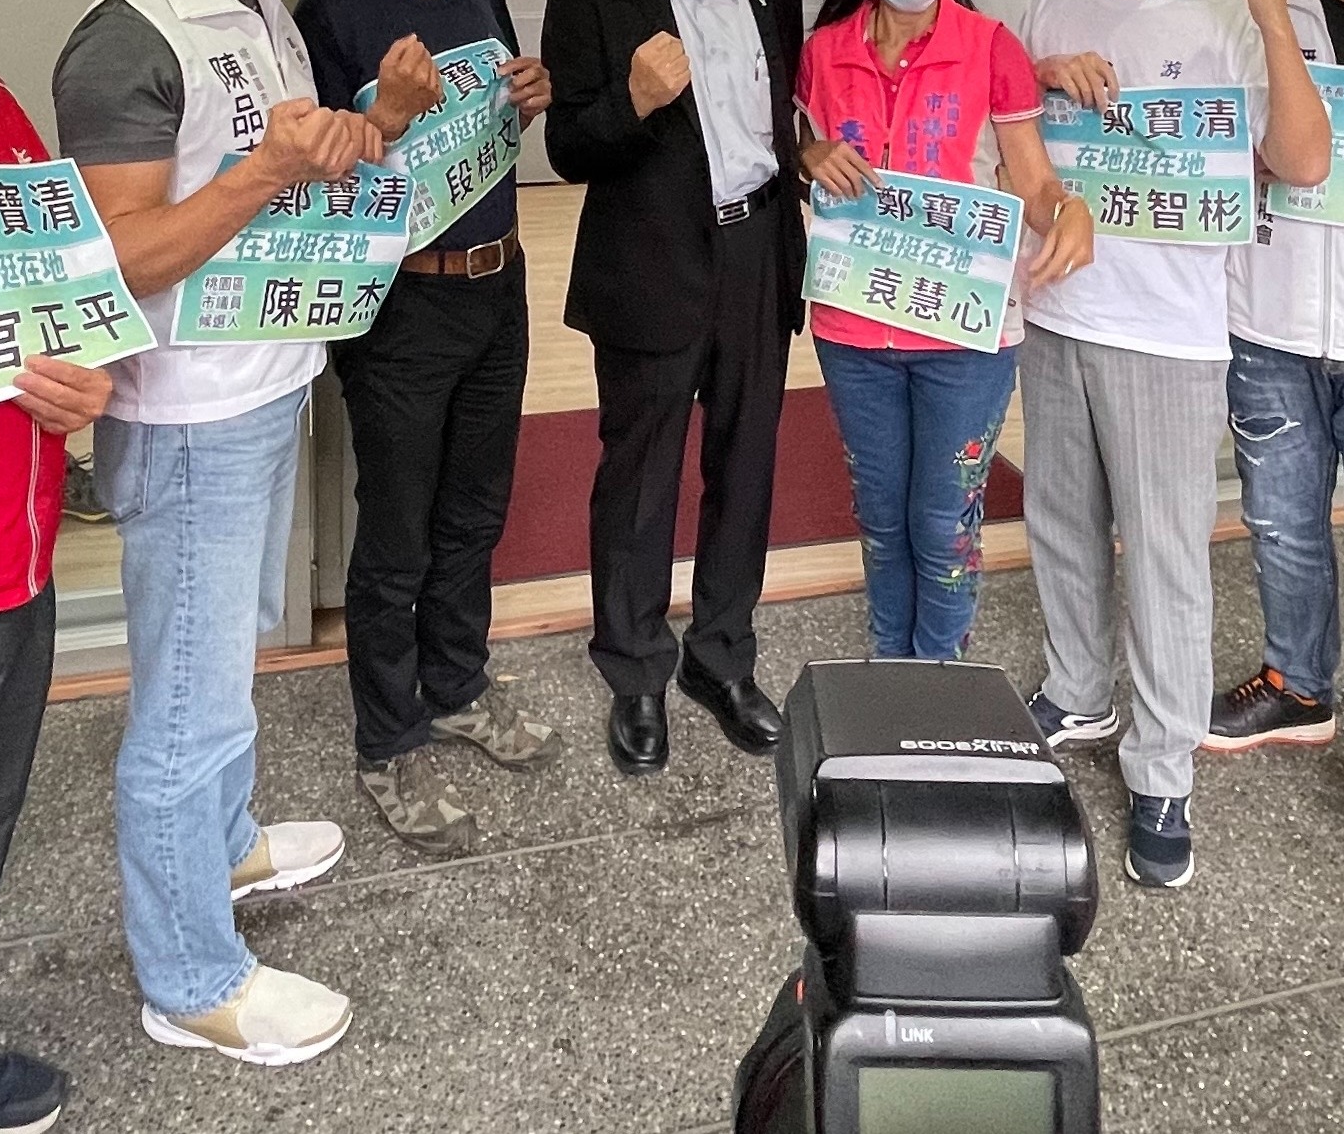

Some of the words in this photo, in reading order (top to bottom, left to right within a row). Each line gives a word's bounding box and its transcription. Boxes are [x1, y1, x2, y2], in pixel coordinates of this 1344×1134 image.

[1102, 98, 1238, 140] 鄭寶清
[445, 117, 517, 207] 段樹文
[1075, 145, 1207, 178] 在地挺在地
[269, 176, 406, 221] 鄭寶清
[876, 185, 1011, 245] 鄭寶清
[1099, 184, 1244, 233] 游智彬
[236, 230, 370, 263] 在地挺在地
[848, 223, 974, 276] 在地挺在地
[260, 277, 386, 328] 陳品杰
[861, 267, 992, 335] 袁慧心
[901, 1027, 934, 1043] LINK
